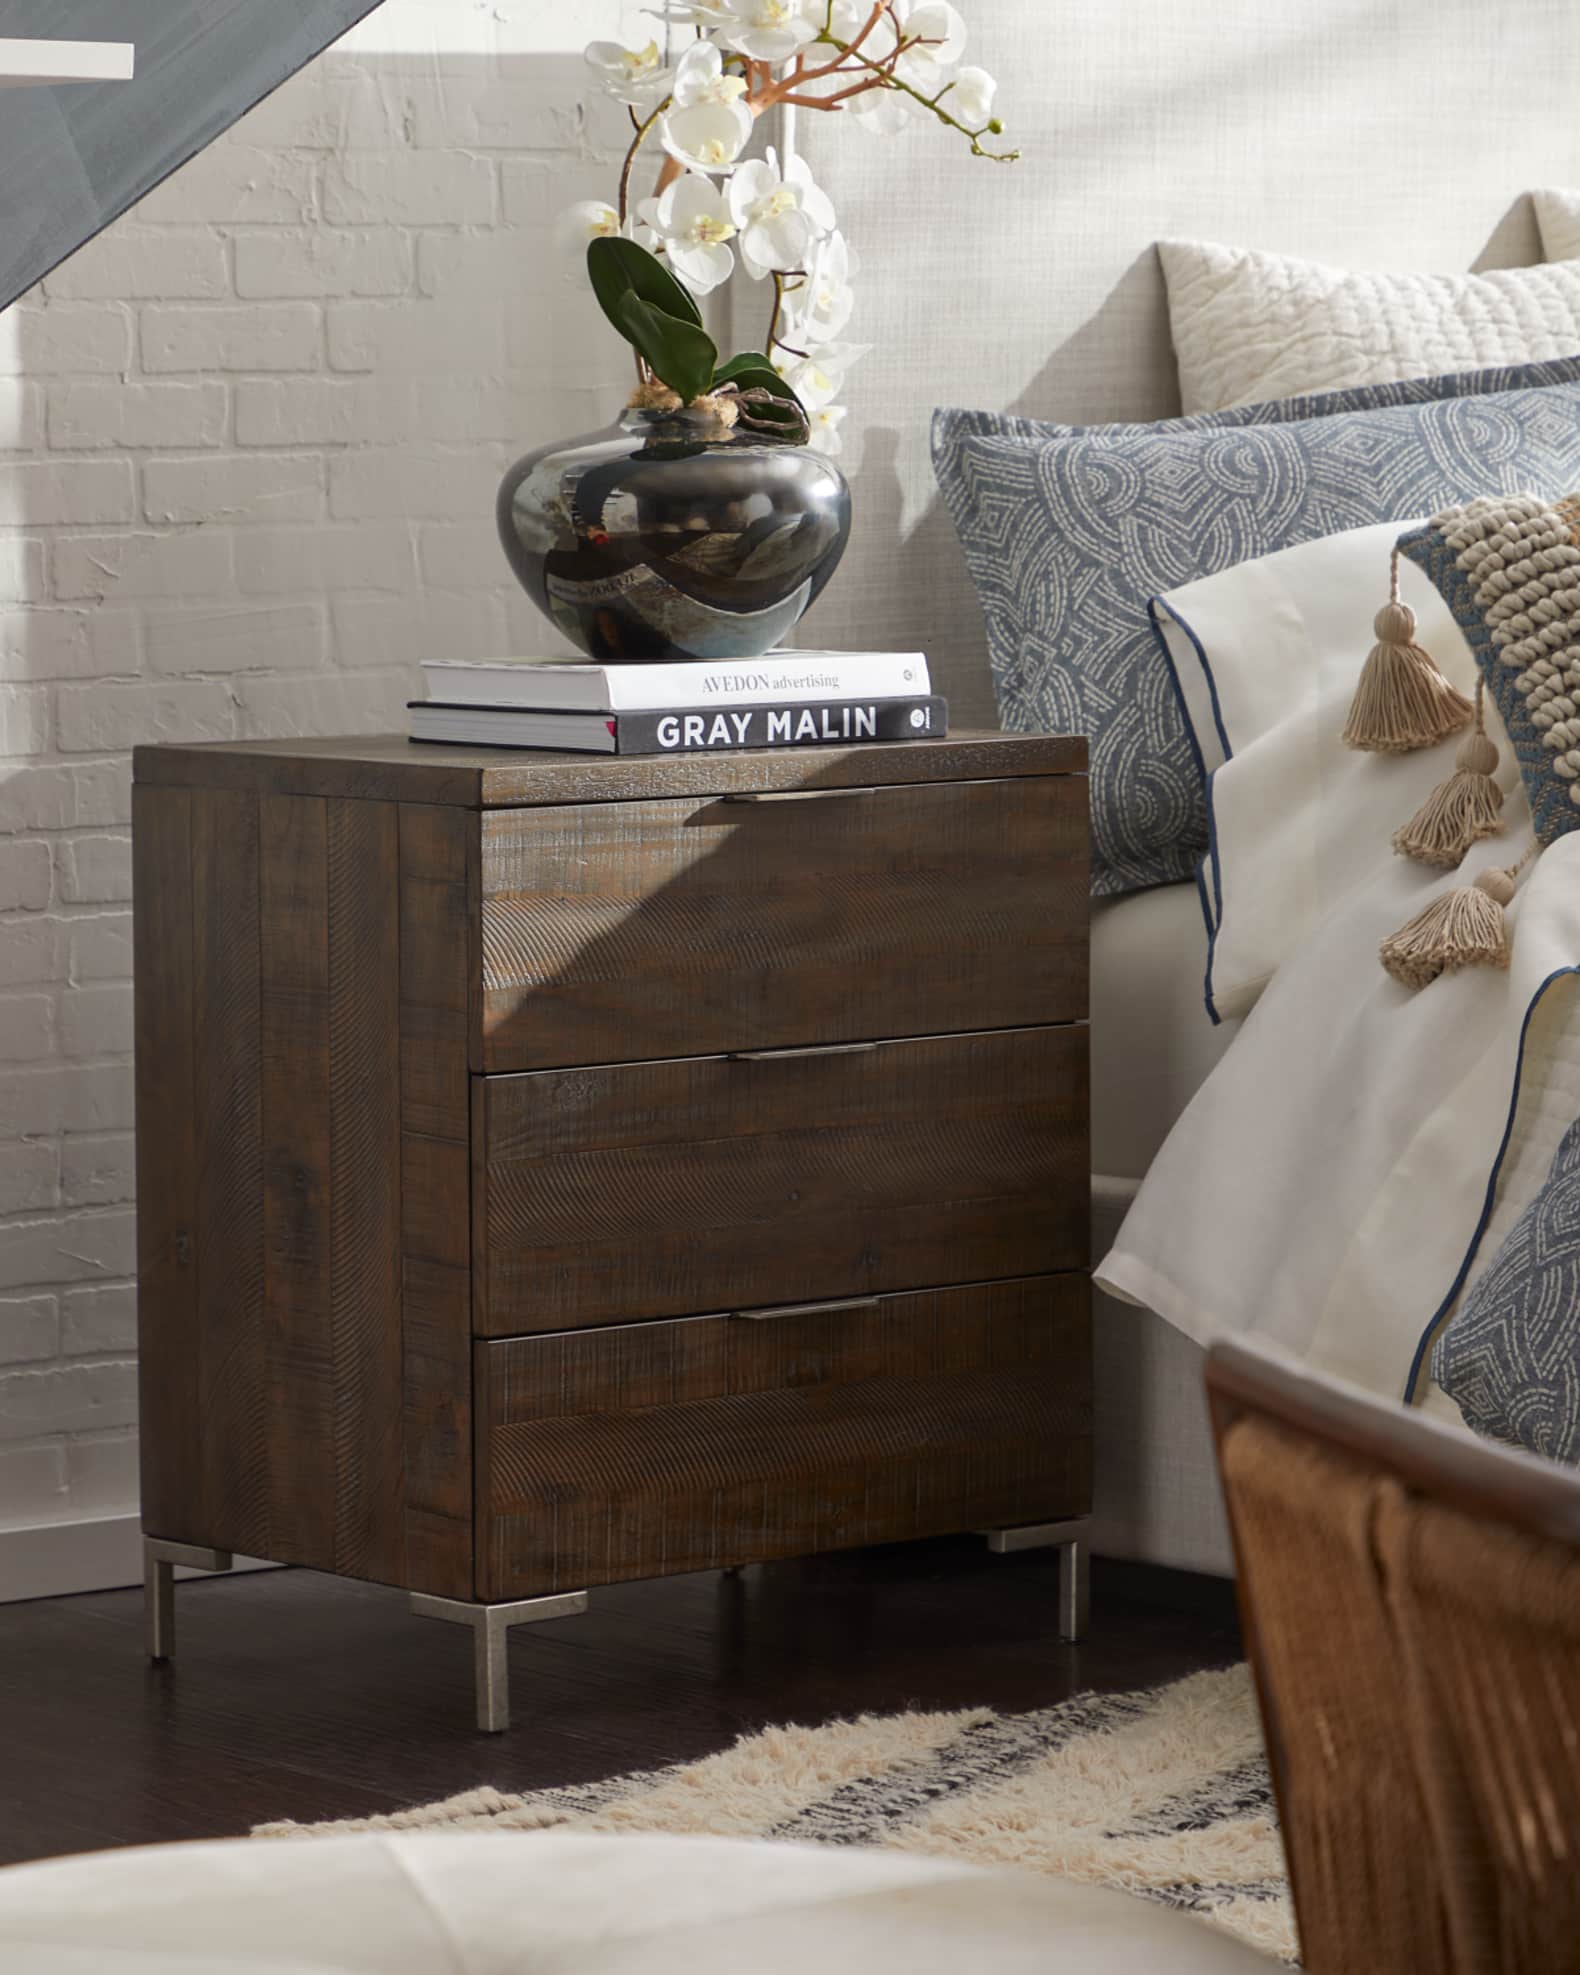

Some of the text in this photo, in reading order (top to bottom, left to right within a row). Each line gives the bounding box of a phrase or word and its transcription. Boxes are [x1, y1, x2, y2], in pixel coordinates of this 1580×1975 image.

[702, 673, 840, 693] AVEDON advertising
[656, 706, 876, 748] GRAY MALIN
